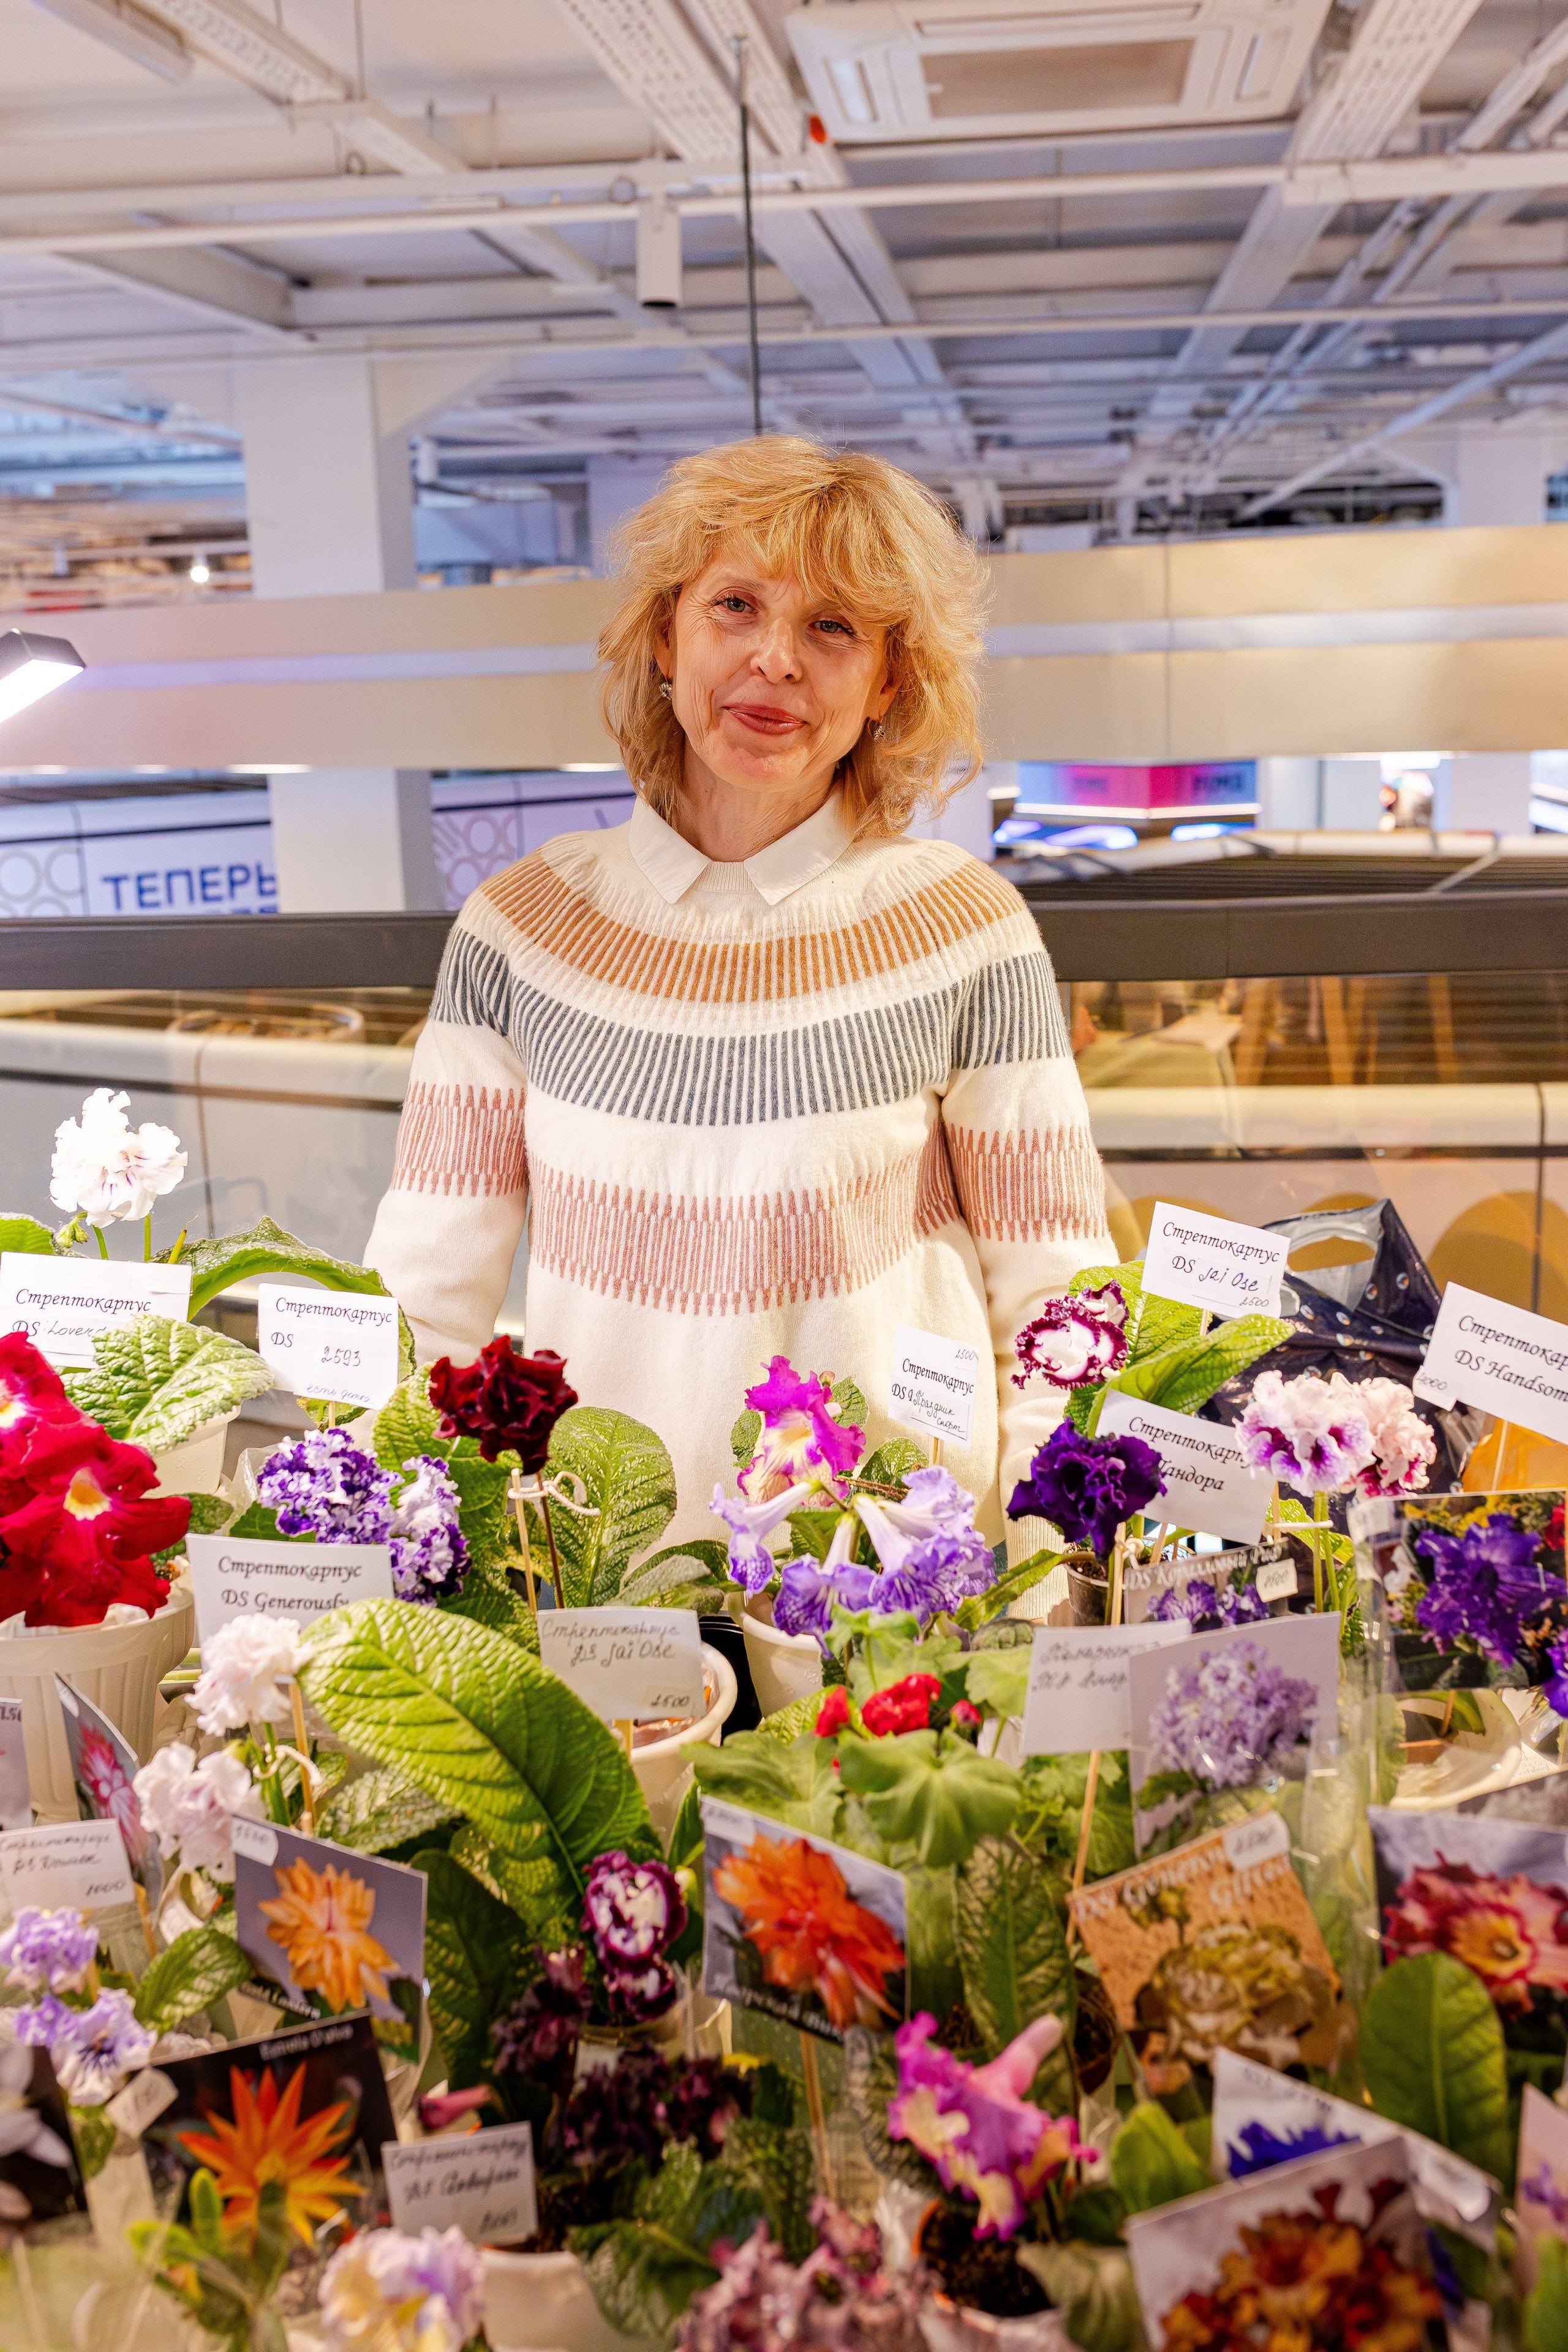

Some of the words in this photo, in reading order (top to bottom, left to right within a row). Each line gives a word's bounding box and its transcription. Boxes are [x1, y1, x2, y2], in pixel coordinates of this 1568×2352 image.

[102, 862, 277, 911] ТЕПЕРЬ
[1163, 1222, 1280, 1264] Стрептокарпус
[1172, 1256, 1196, 1273] DS
[16, 1289, 152, 1314] Стрептокарпус
[276, 1297, 392, 1326] Стрептокарпус
[12, 1321, 40, 1336] DS
[271, 1332, 294, 1348] DS
[1455, 1349, 1485, 1371] DS
[902, 1359, 974, 1396] Стрептокарпус
[892, 1384, 907, 1400] DS
[218, 1556, 363, 1583] Стрептокарпус
[221, 1588, 249, 1607] DS
